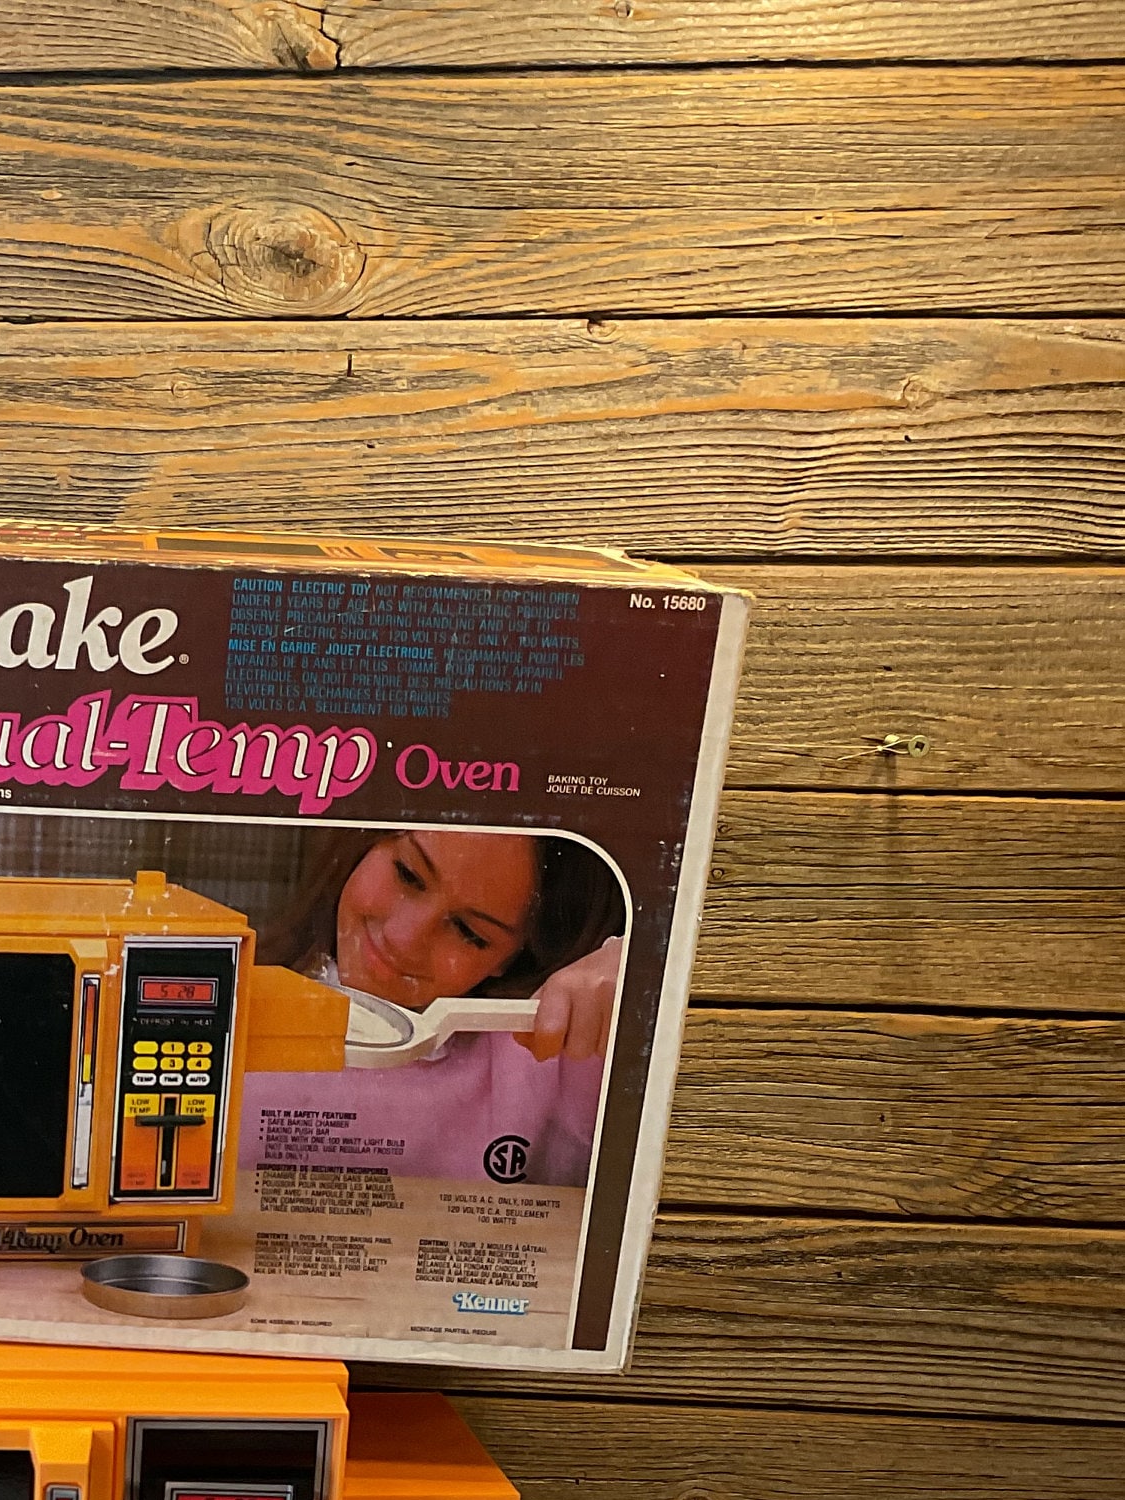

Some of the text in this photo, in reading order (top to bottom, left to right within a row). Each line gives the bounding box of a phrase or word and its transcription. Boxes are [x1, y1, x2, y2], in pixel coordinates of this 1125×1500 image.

[292, 580, 346, 595] ELECTRIC
[375, 585, 398, 597] NOT
[402, 585, 491, 602] RECOMMENDED
[496, 590, 519, 603] FOR
[523, 591, 580, 605] CHILDREN
[630, 594, 706, 612] No. 15680
[228, 638, 257, 652] MISE
[261, 639, 275, 653] EN
[325, 643, 361, 657] JOUET
[395, 743, 520, 792] Oven
[548, 775, 608, 786] BAKING TOY
[546, 784, 641, 797] JOUET DE CUISSON
[196, 1044, 203, 1052] 2
[169, 1059, 202, 1068] 3 4
[439, 1193, 452, 1202] 120
[455, 1194, 477, 1203] VOLTS
[536, 1199, 561, 1209] WATTS
[448, 1206, 460, 1214] 120
[463, 1206, 485, 1215] VOLTS
[505, 1209, 550, 1219] SEULEMENT
[478, 1216, 517, 1225] 100 WATTS
[69, 1227, 124, 1247] Oven
[452, 1291, 530, 1315] Kenner
